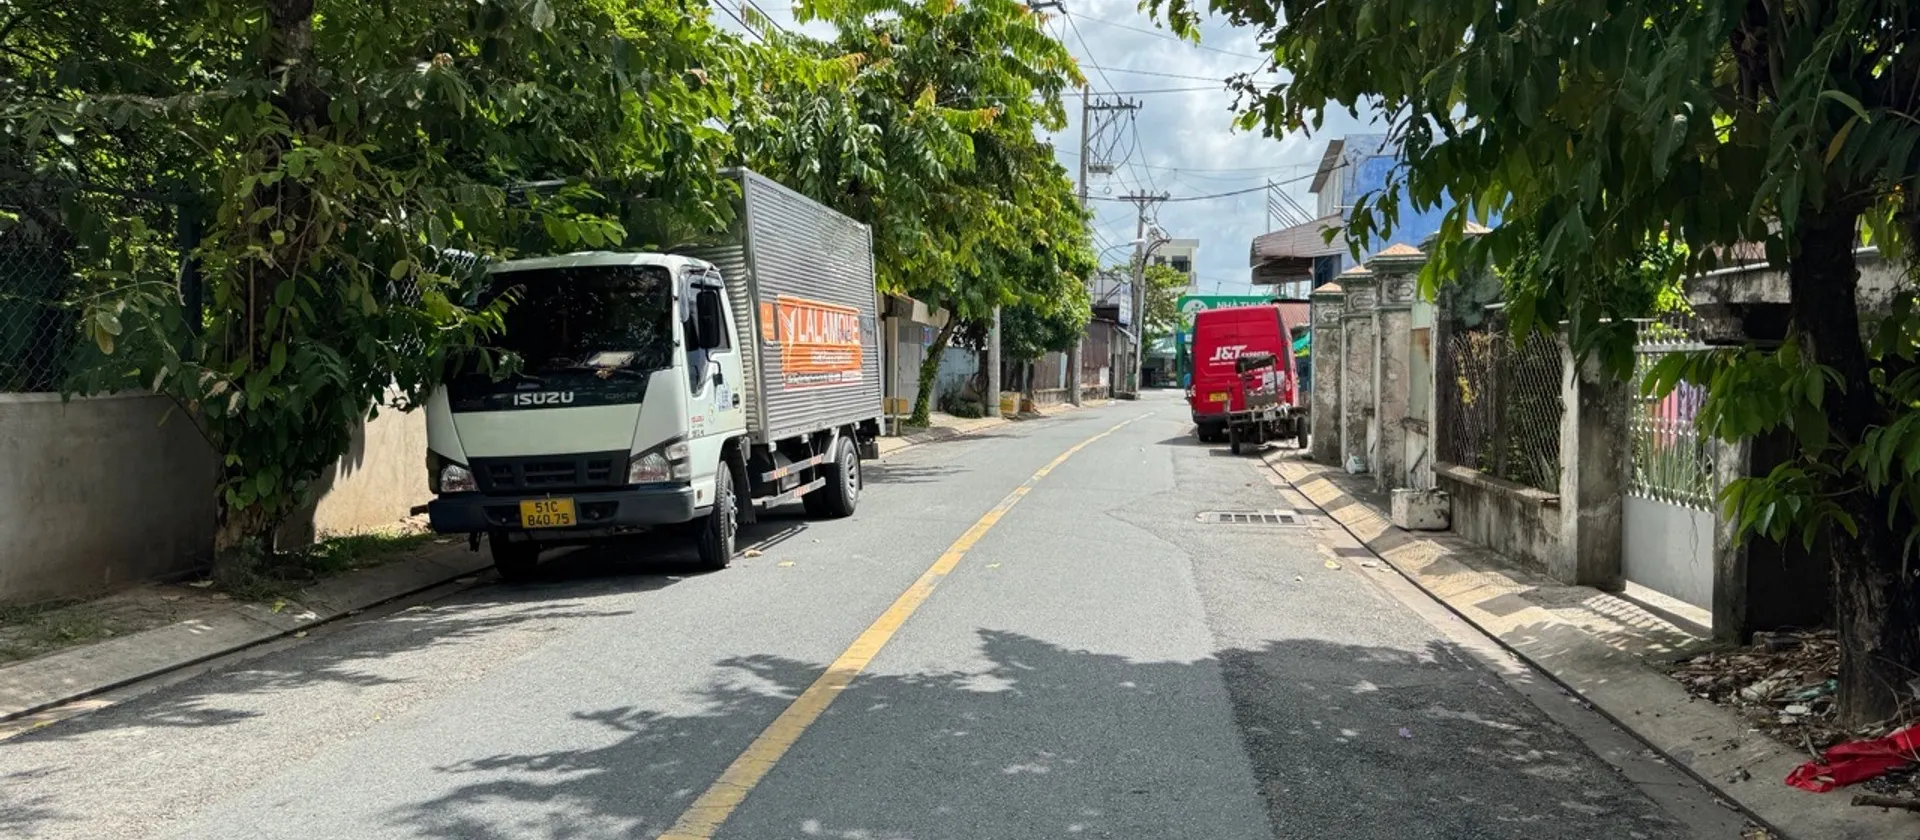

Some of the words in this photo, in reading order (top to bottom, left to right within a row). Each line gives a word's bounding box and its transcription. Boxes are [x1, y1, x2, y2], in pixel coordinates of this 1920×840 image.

[1217, 299, 1236, 309] NHÀ
[1209, 345, 1247, 361] J&T
[514, 391, 574, 405] ISUZU
[535, 501, 558, 513] 51C
[528, 513, 570, 526] 840.75
